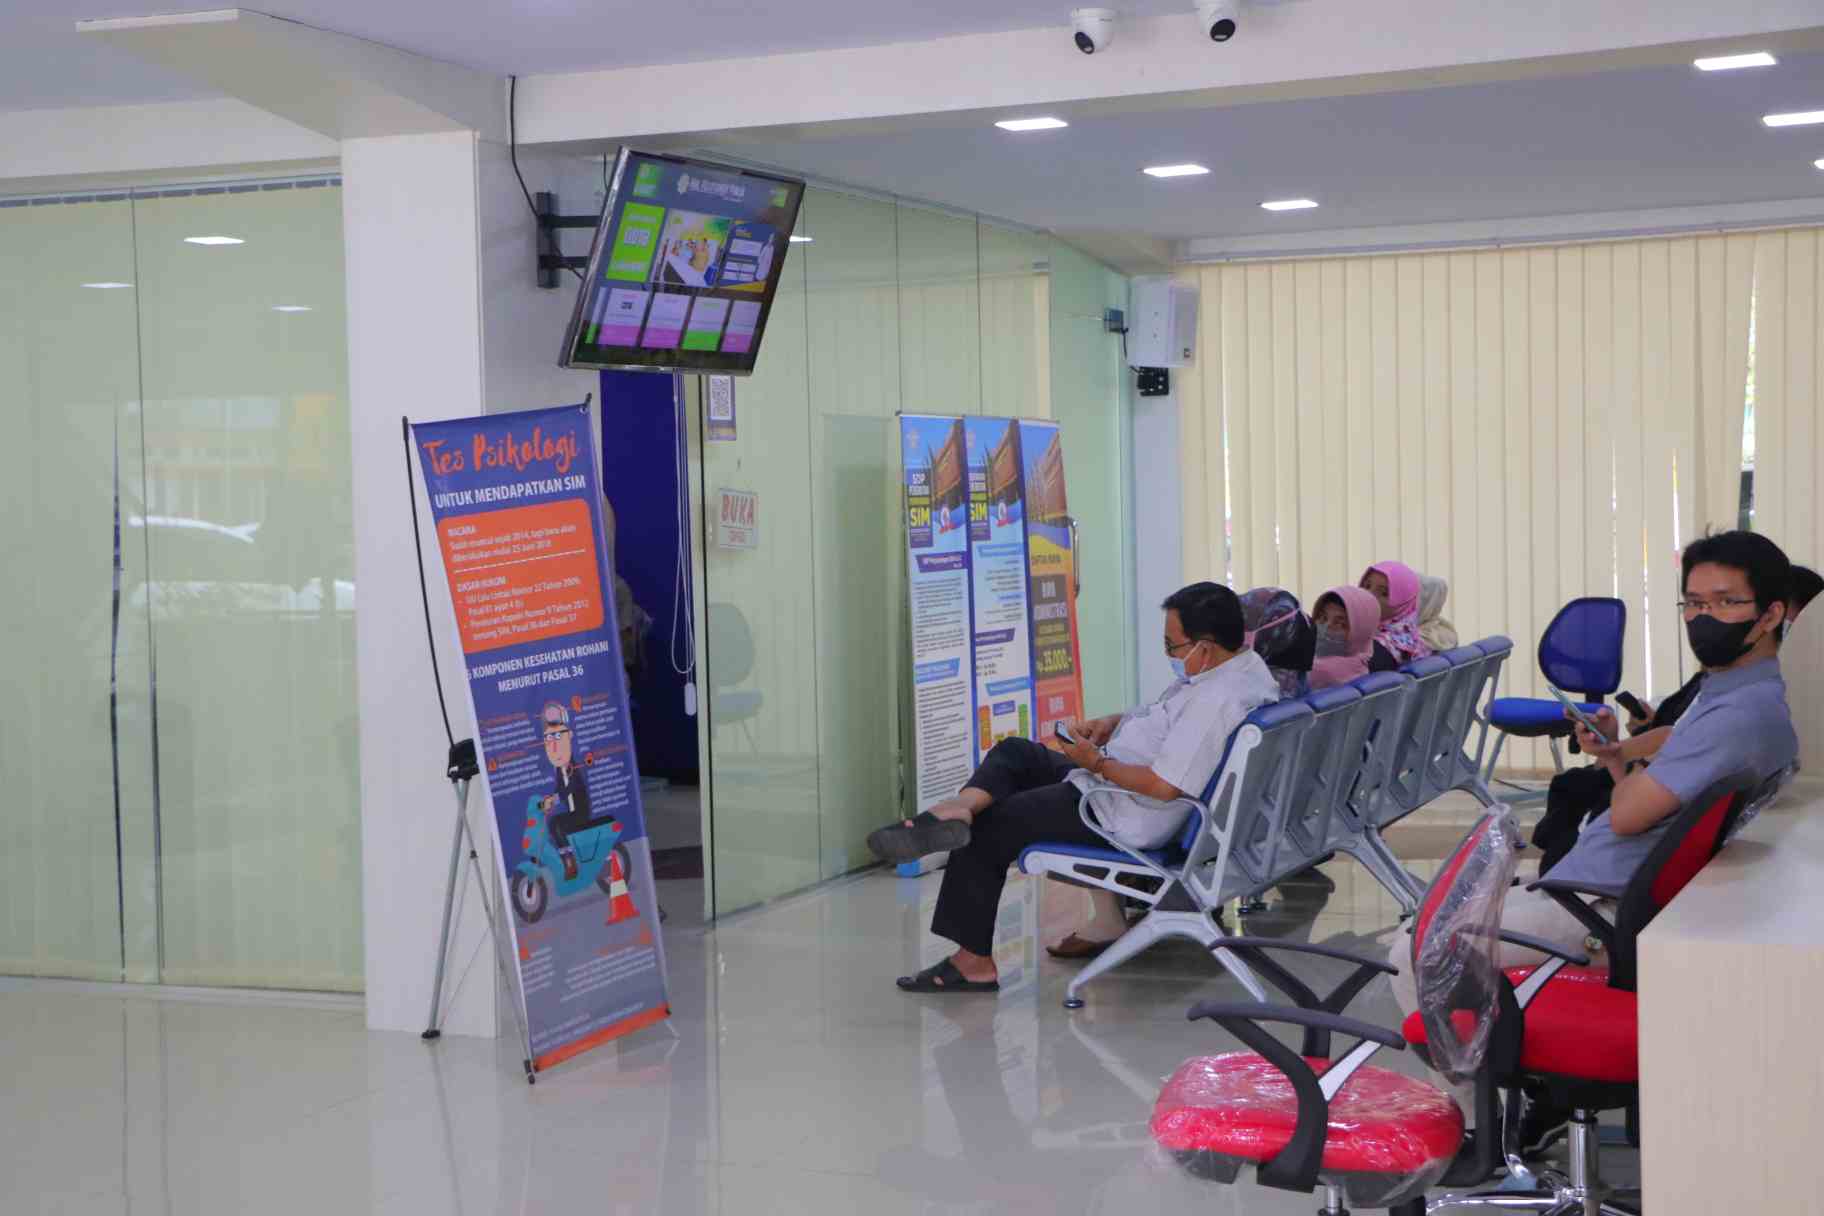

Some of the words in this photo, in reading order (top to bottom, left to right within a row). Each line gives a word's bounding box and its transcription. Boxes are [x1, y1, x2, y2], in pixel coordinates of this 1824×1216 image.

[423, 439, 464, 475] Tes
[473, 426, 577, 473] Psikologi
[435, 490, 474, 508] UNTUK
[475, 479, 563, 503] MENDAPATKAN
[564, 475, 586, 490] SIM
[910, 507, 931, 526] SIM
[472, 660, 523, 680] KOMPONEN
[523, 648, 575, 668] KESEHATAN
[576, 640, 609, 657] ROHANI
[498, 672, 542, 692] MENURUT
[542, 667, 571, 683] PASAL
[572, 665, 584, 677] 36
